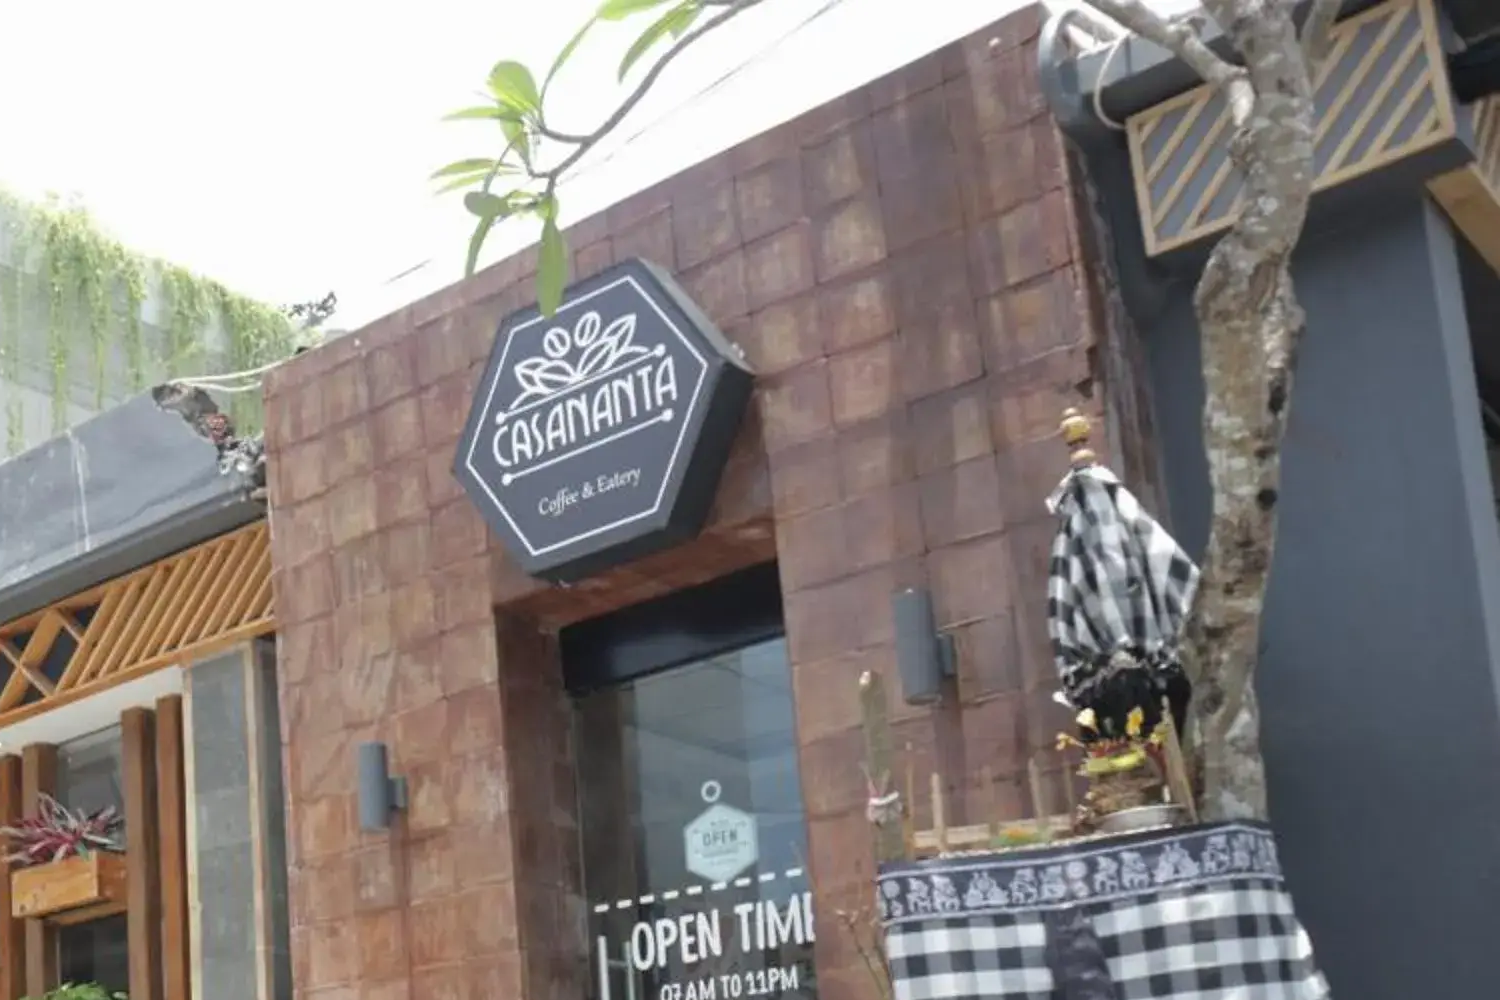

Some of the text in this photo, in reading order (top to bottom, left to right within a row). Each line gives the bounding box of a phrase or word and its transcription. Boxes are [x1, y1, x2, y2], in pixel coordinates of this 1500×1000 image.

[492, 355, 679, 467] CASANANTA
[538, 467, 641, 517] Coffee & Eatery
[701, 828, 738, 848] OPEN
[631, 907, 722, 971] OPEN
[720, 973, 742, 998] TO
[745, 964, 799, 995] 11PM
